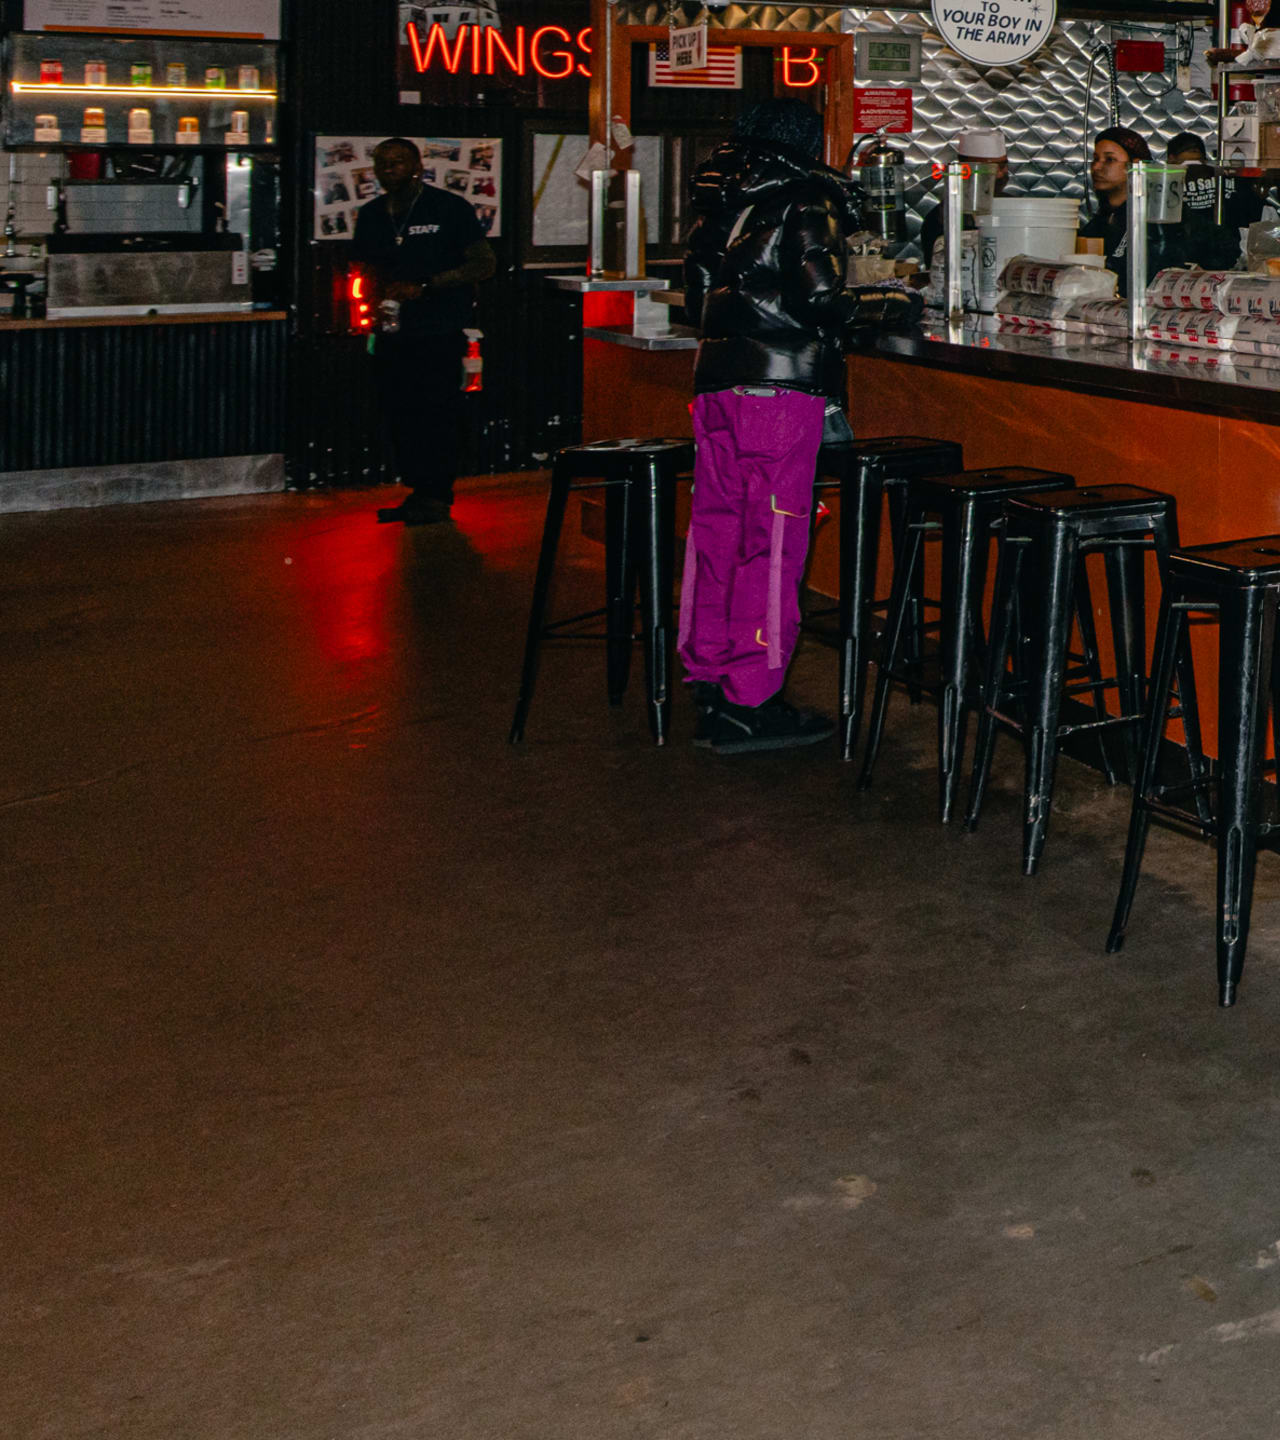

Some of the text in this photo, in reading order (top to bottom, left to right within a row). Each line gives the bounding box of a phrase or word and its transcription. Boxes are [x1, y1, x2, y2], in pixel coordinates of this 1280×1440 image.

[981, 1, 1000, 13] TO
[943, 9, 1042, 32] YOUR BOY IN
[956, 26, 1031, 46] THE ARMY
[408, 224, 440, 236] STAFF
